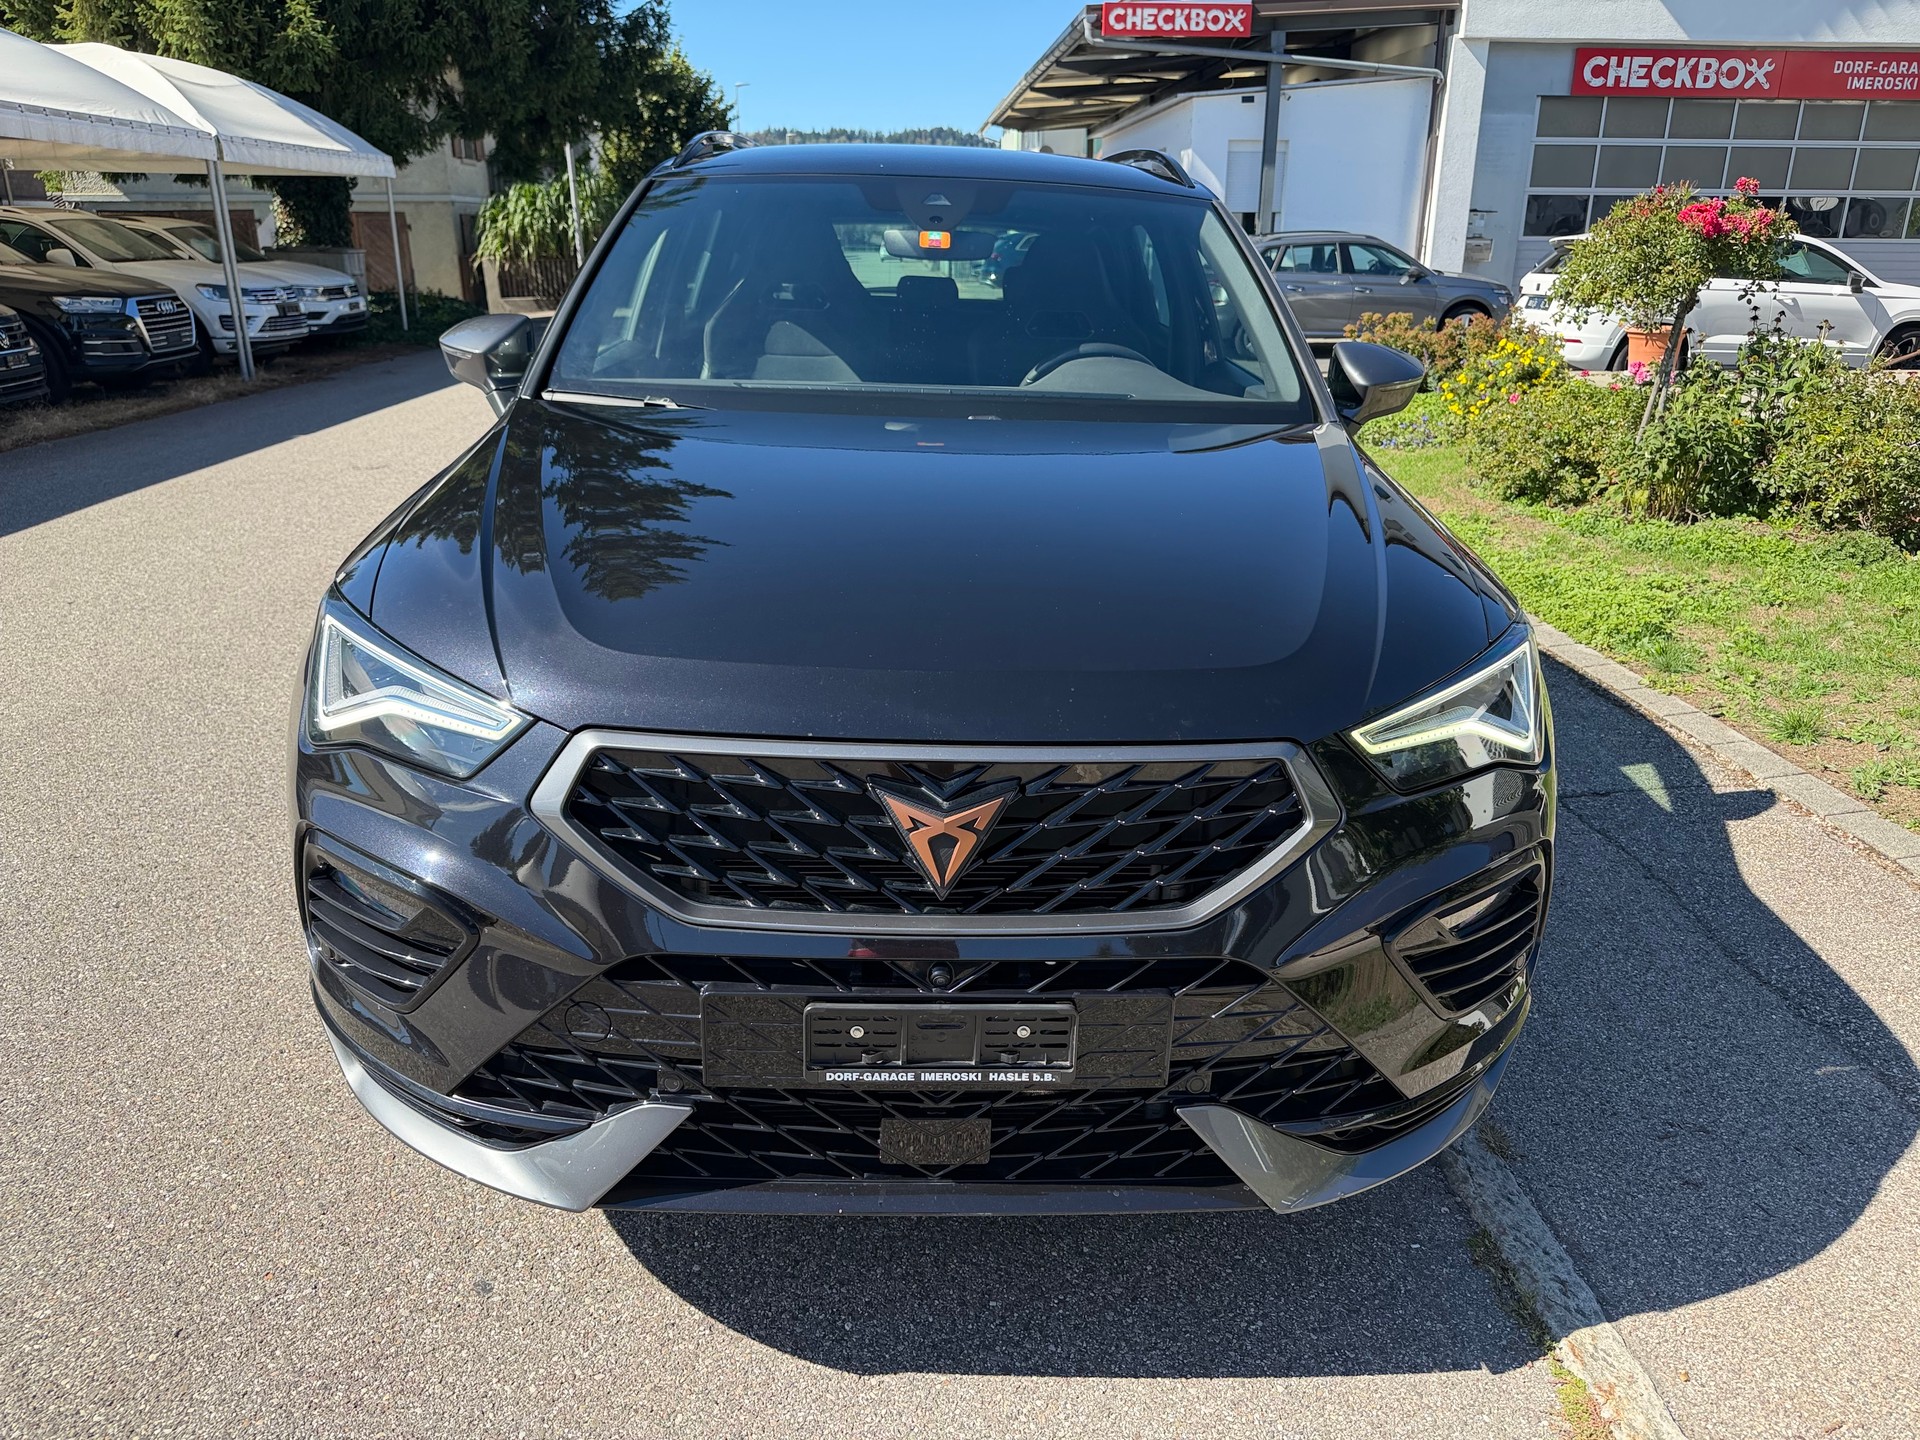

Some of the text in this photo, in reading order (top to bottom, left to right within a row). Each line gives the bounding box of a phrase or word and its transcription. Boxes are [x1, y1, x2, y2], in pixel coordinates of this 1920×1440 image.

[1108, 7, 1247, 32] CHECKBOX
[1583, 55, 1776, 90] CHECKBOX
[1833, 60, 1920, 75] DORF-GARA
[1846, 76, 1919, 90] IMEROSKI
[825, 1072, 1056, 1082] DORF-GARAGE IMEROSKI HASLE b.B.
